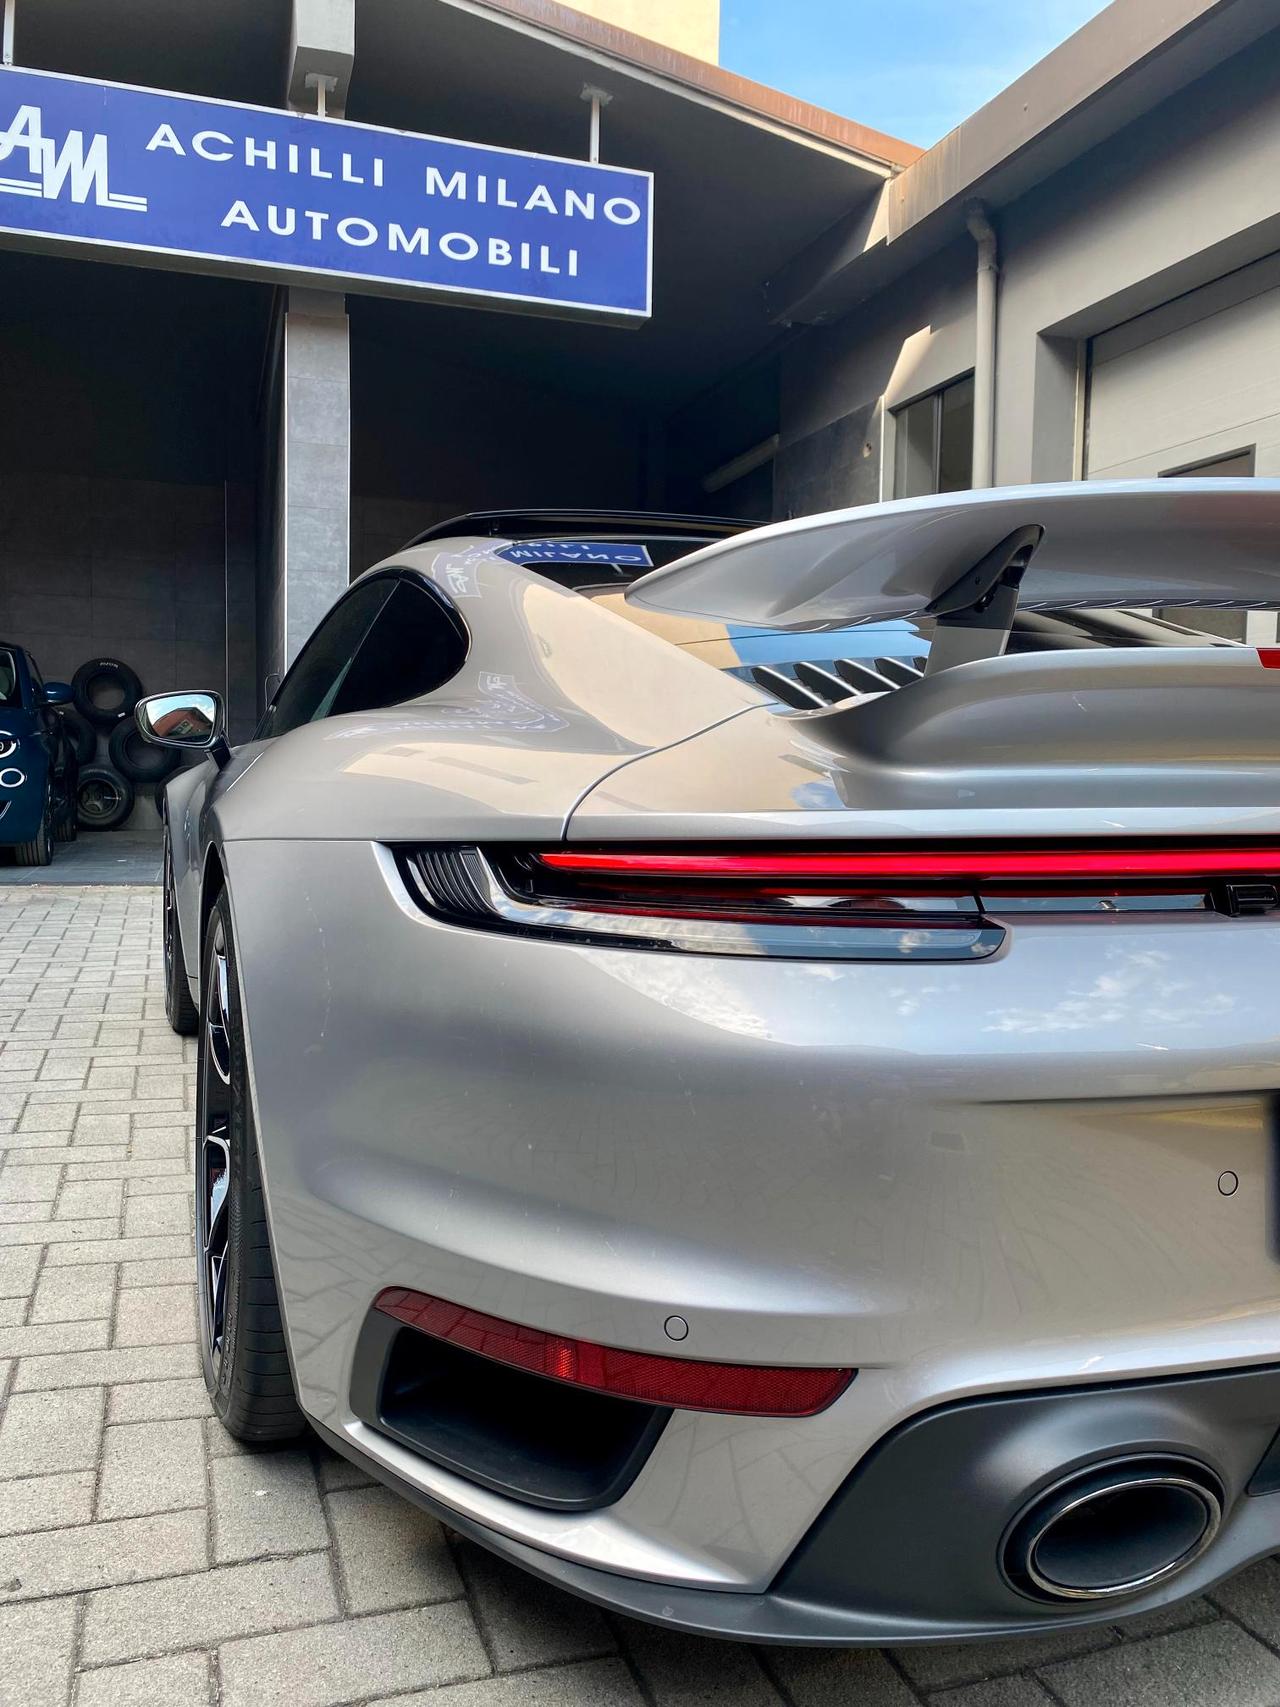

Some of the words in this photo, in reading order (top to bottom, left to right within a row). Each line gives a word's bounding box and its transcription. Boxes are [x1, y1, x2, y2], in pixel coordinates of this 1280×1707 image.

[145, 123, 383, 187] ACHILLI
[426, 166, 641, 225] MILANO
[220, 200, 578, 277] AUTOMOBILI
